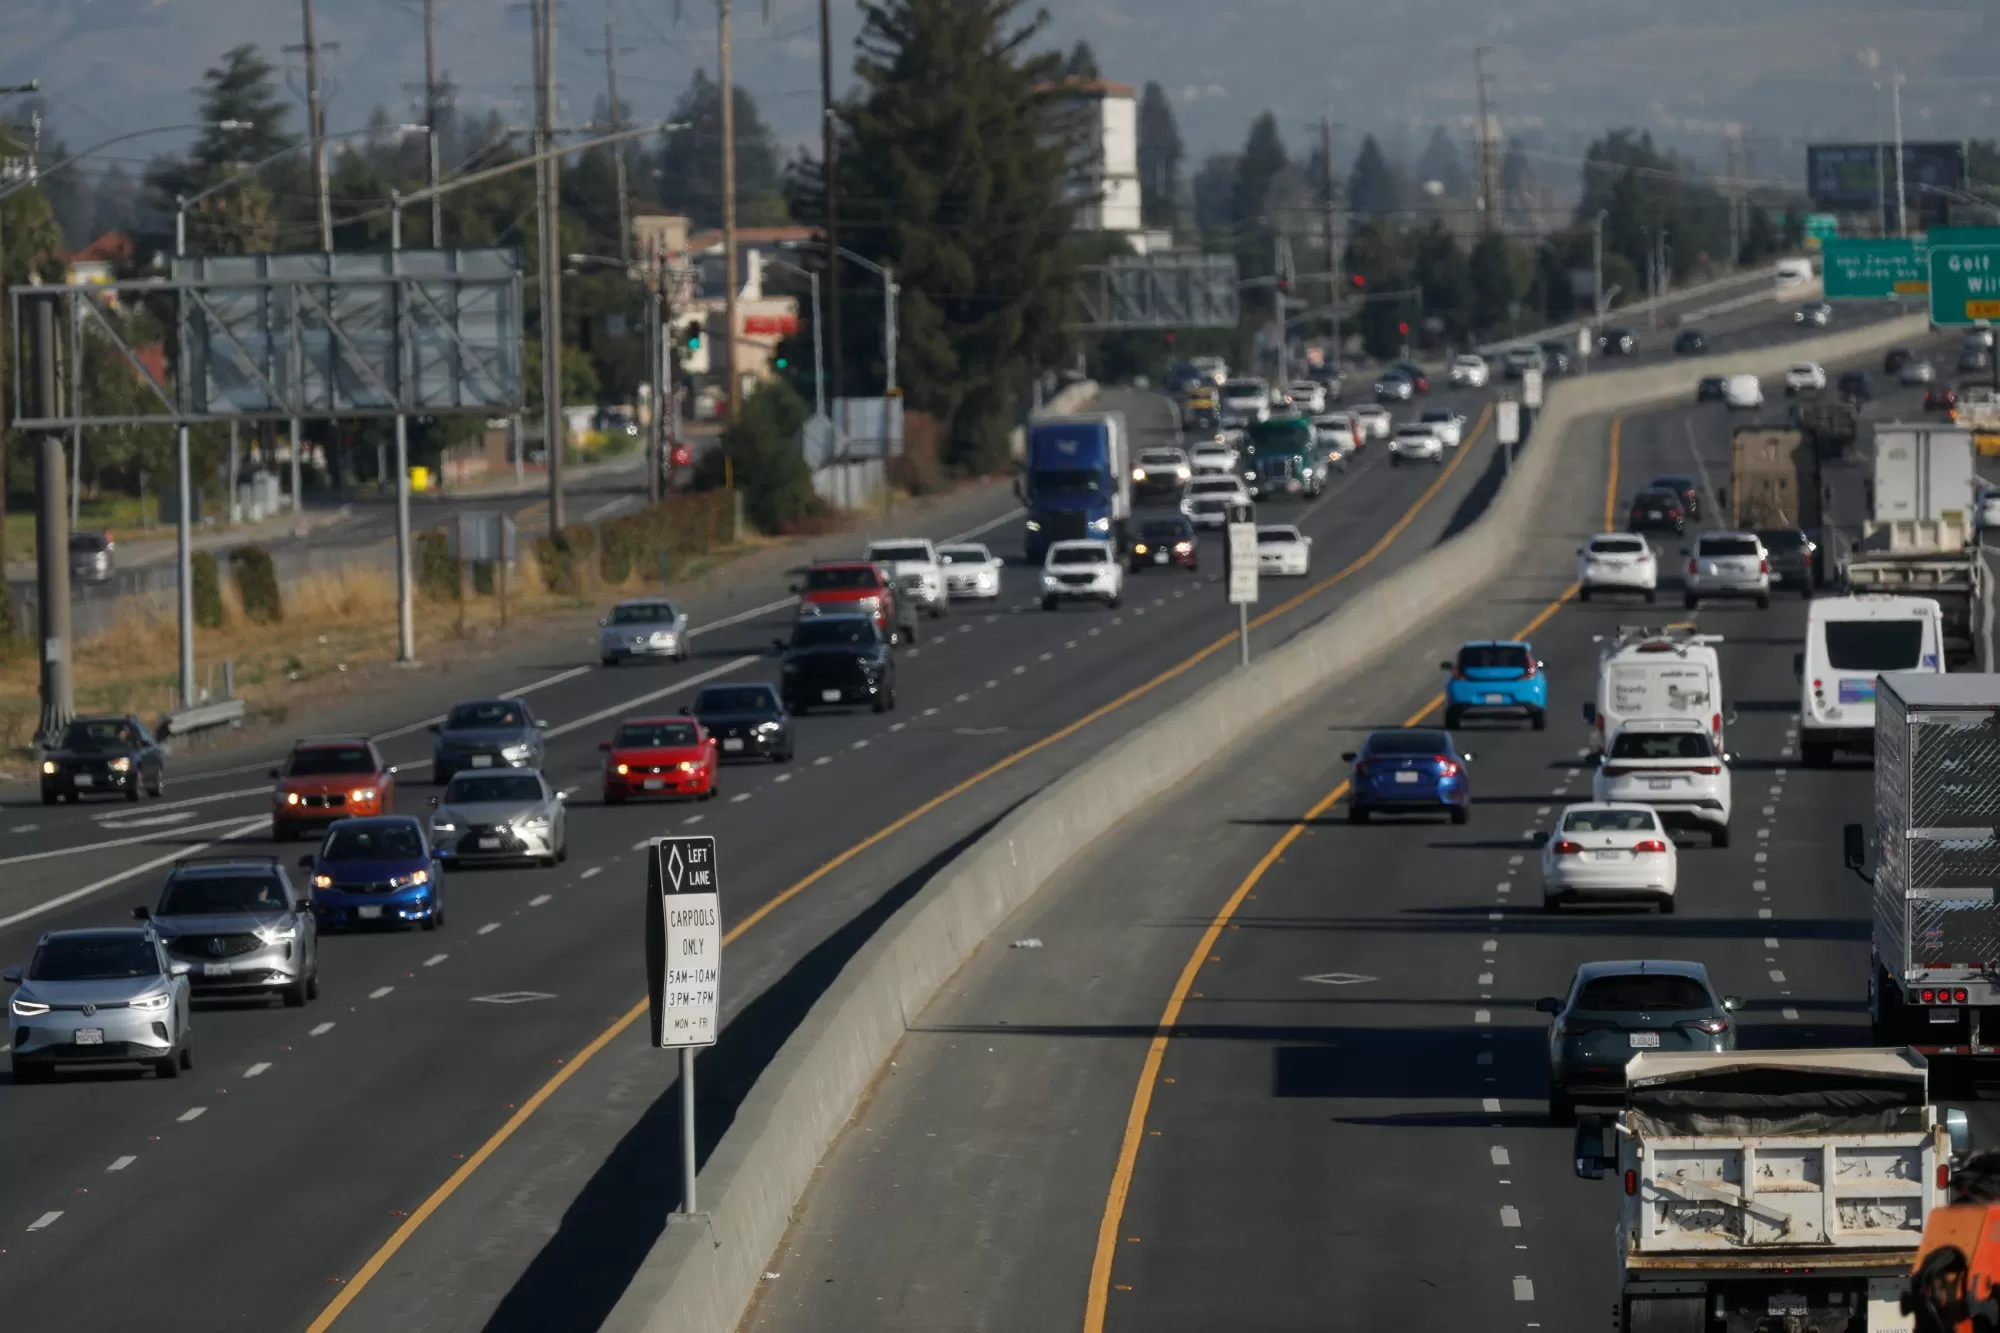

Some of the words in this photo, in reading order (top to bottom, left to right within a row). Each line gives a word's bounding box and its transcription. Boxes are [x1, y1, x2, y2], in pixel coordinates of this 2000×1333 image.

[1948, 254, 1990, 272] Golf
[688, 848, 707, 863] LEFT
[689, 870, 711, 886] LANE
[670, 908, 715, 928] CARPOOLS
[682, 938, 704, 956] ONLY
[668, 969, 717, 984] 5AM-10AM
[669, 991, 714, 1006] 3PM-7PM
[674, 1018, 688, 1029] MON
[698, 1016, 708, 1028] FRI
